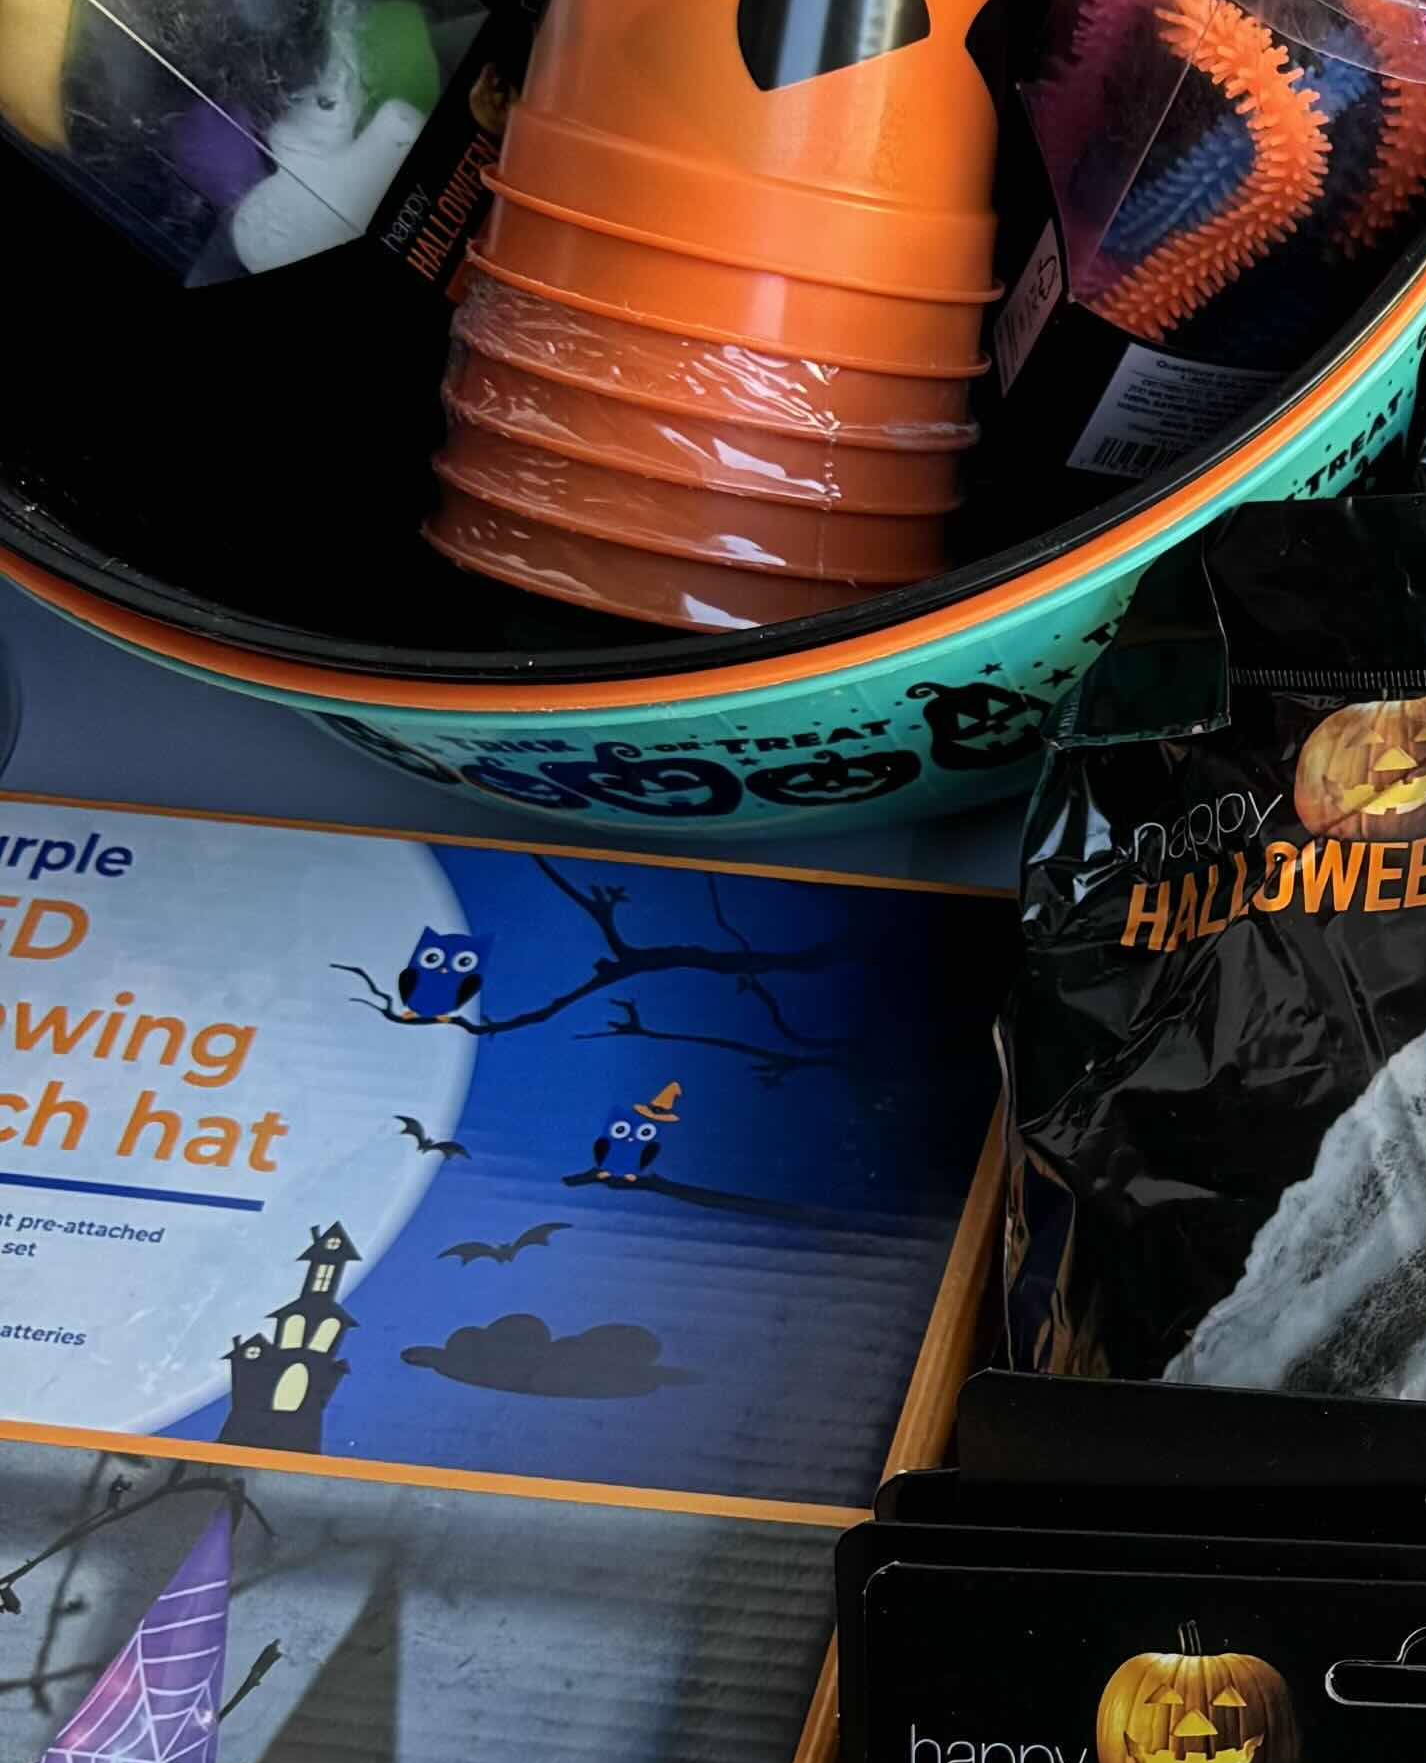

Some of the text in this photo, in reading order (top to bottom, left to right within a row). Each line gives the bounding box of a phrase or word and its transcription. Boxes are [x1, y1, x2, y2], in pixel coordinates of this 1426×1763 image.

[714, 720, 893, 757] TREAT
[0, 989, 258, 1088] wing
[115, 1089, 290, 1173] hat
[16, 1214, 166, 1245] pre-attached
